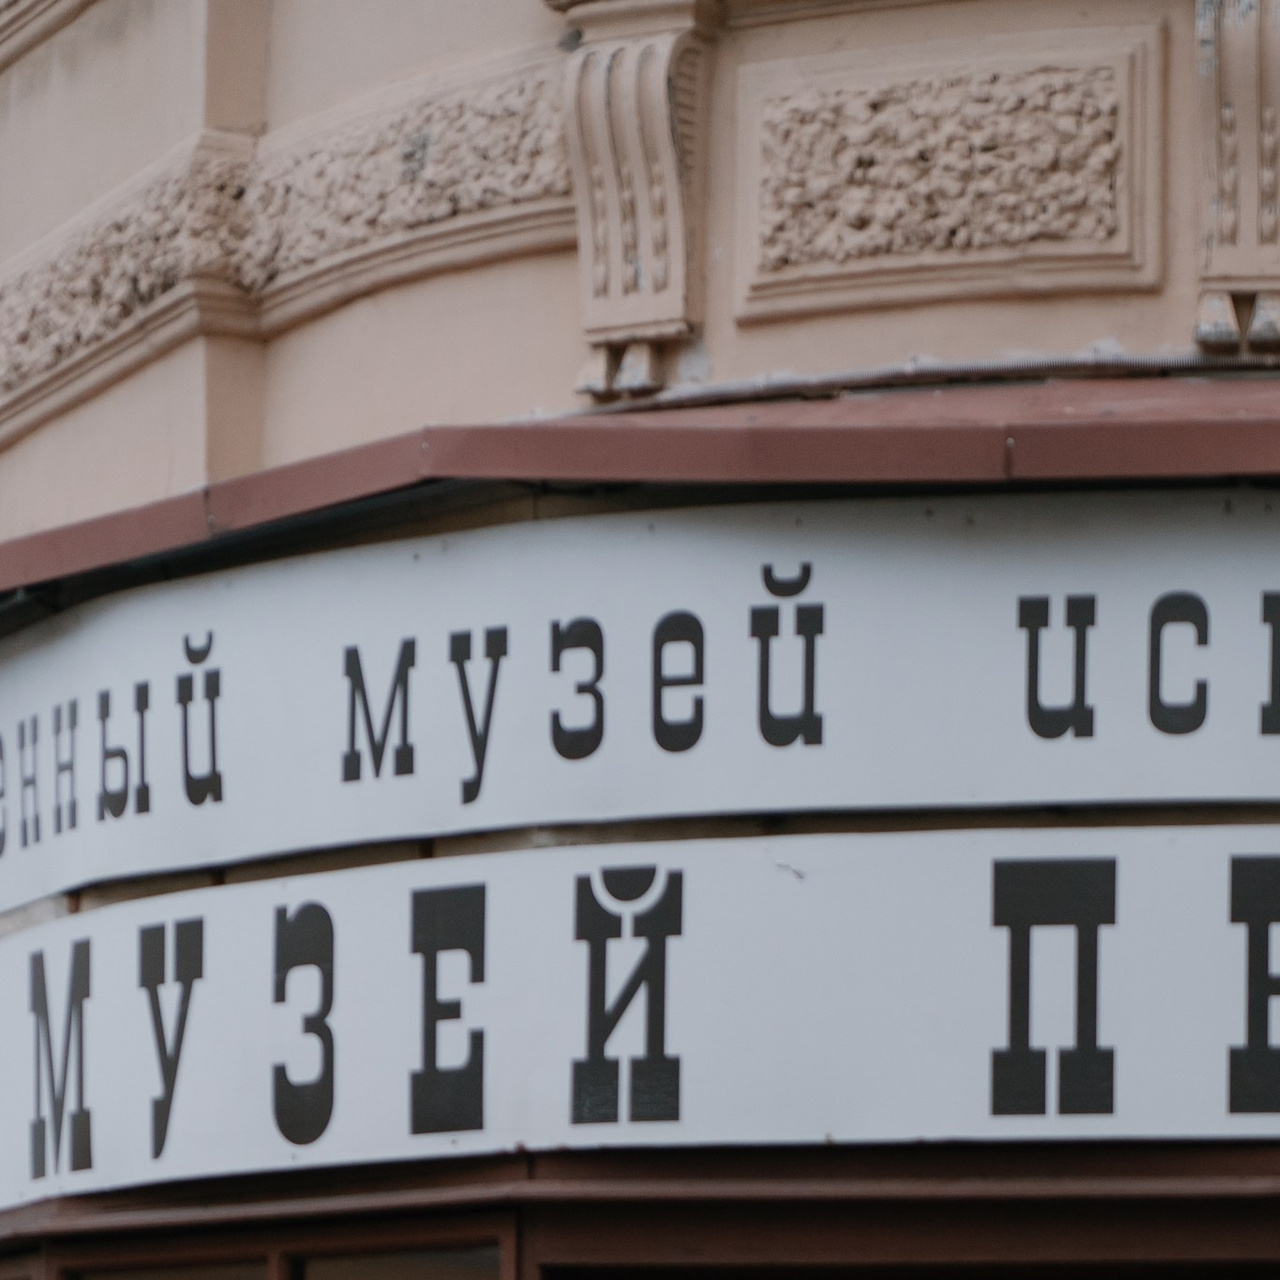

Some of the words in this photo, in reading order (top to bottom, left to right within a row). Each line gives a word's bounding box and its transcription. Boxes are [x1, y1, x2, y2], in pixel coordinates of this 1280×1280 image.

[0, 630, 224, 858] нный
[341, 561, 825, 805] музей
[28, 865, 685, 1181] МУЗЕЙ
